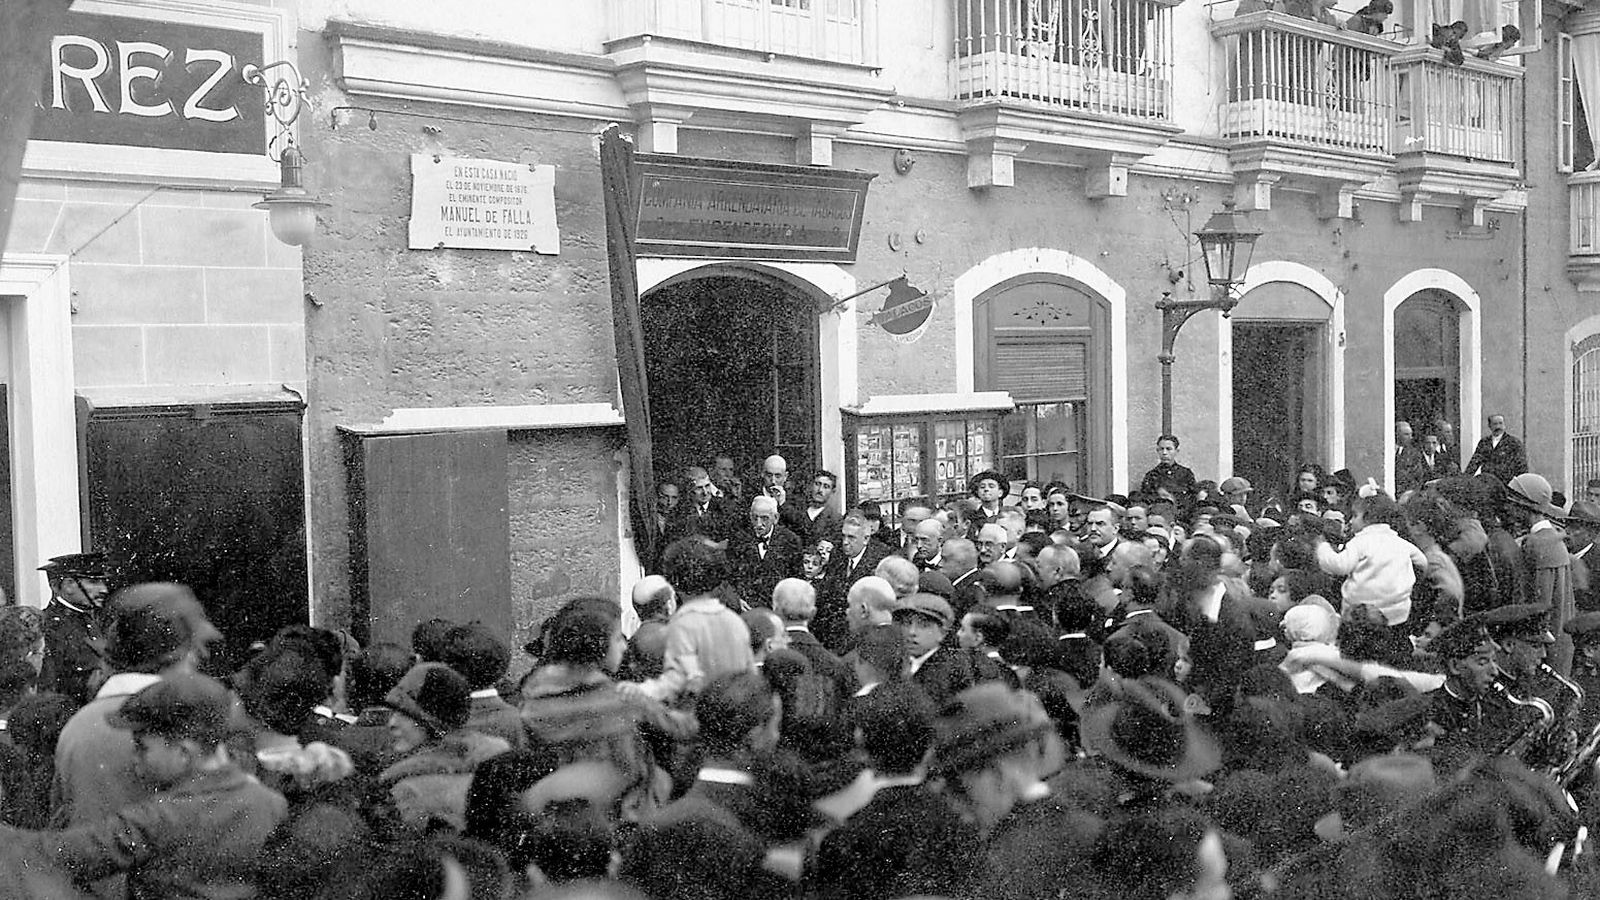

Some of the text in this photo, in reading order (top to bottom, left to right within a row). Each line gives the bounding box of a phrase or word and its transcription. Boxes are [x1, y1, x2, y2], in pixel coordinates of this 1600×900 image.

[35, 35, 243, 123] REZ
[454, 166, 463, 178] EN
[464, 167, 480, 179] ESTA
[482, 168, 497, 180] CASA
[446, 180, 454, 190] EL
[455, 181, 463, 190] 23
[464, 182, 472, 191] DE
[473, 182, 505, 193] NOVIEMBRE
[506, 184, 514, 193] DE
[449, 193, 522, 206] EL EMINENTE COMPOSITOR
[441, 206, 535, 225] MANUEL DE FALLA.
[444, 226, 529, 239] EL AYUNTAMIENTO DE 1926
